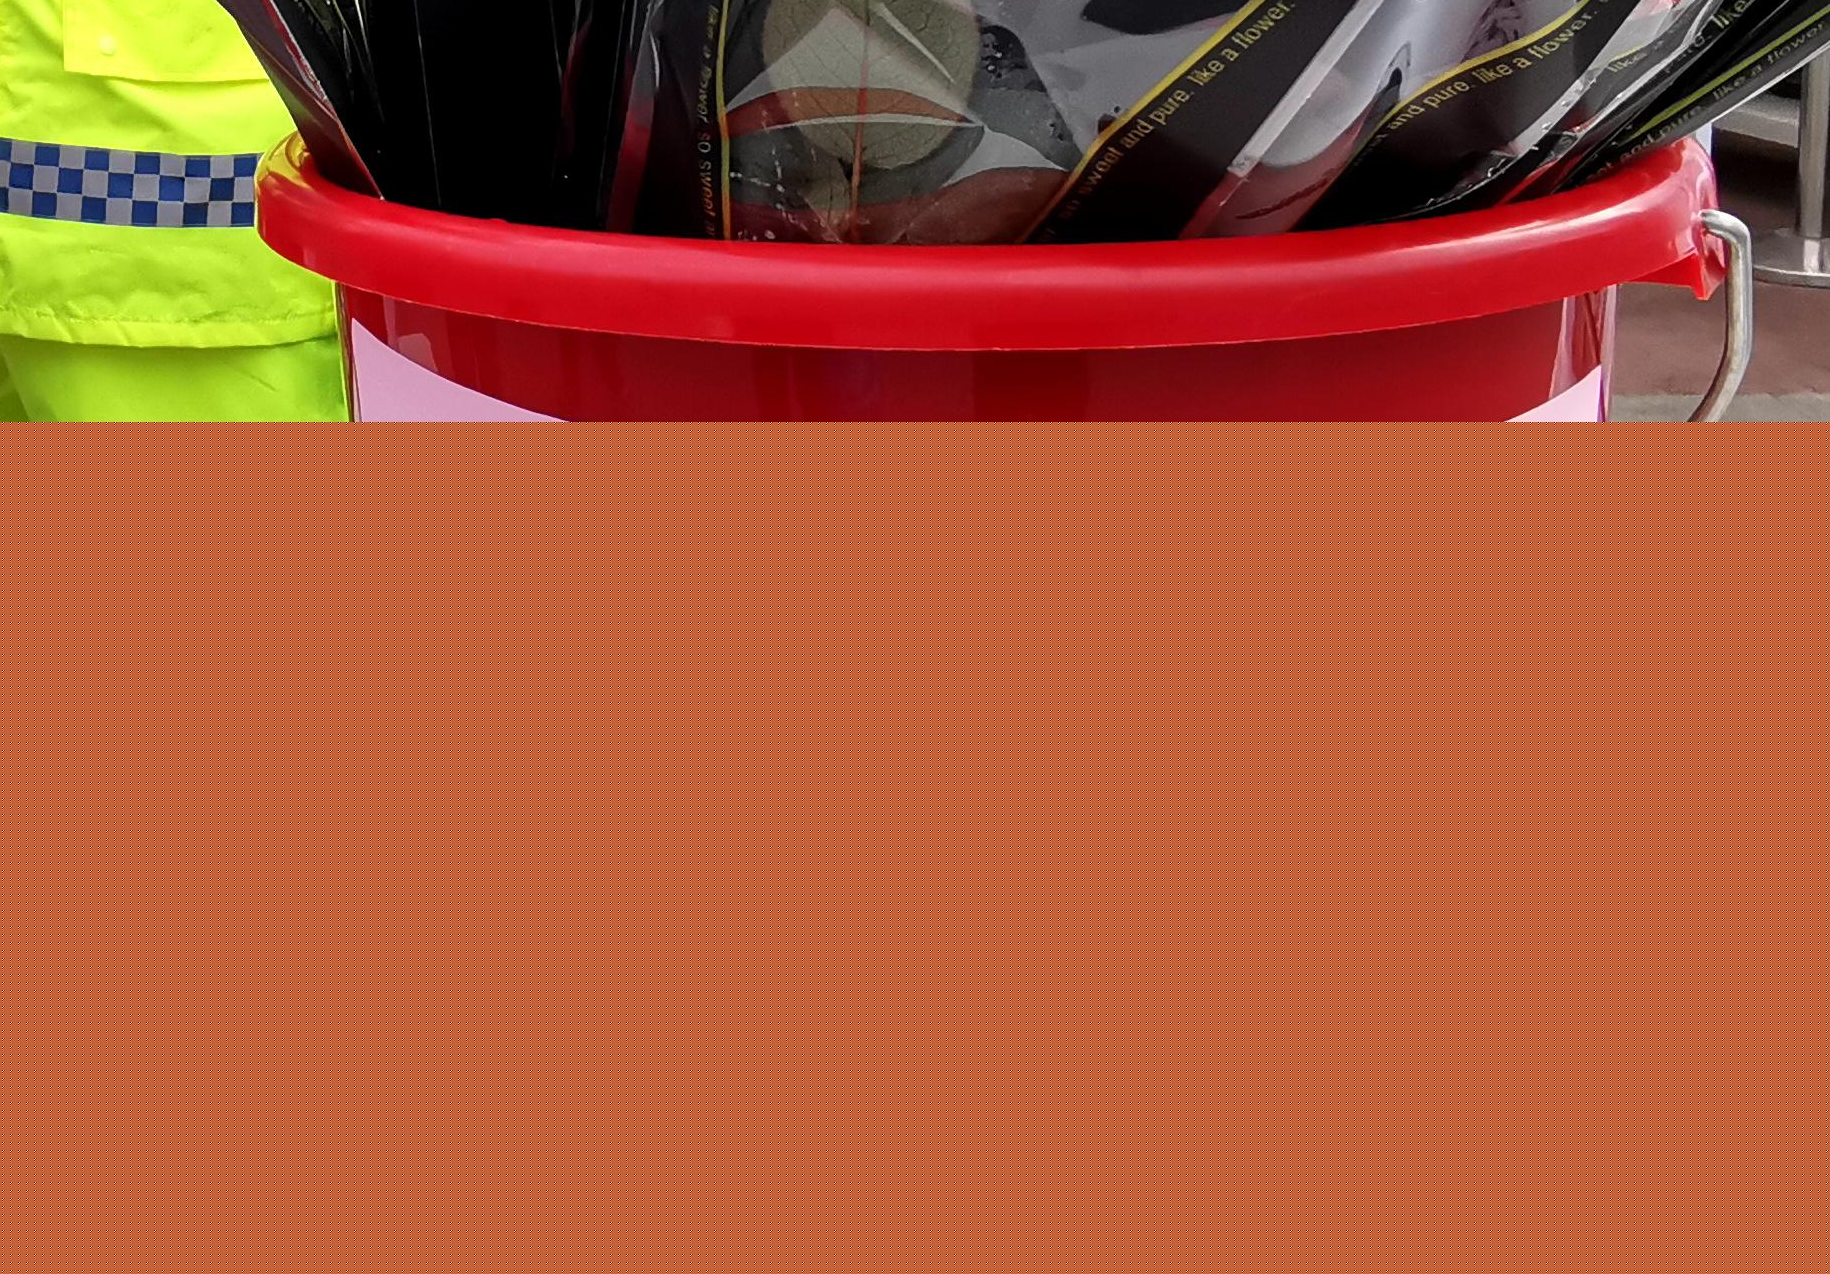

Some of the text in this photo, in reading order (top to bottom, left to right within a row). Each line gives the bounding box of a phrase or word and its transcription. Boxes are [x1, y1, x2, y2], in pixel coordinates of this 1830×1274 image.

[1711, 0, 1746, 29] like
[1120, 118, 1155, 150] and
[1187, 59, 1225, 86] like
[1222, 46, 1239, 61] a
[1387, 102, 1425, 130] and
[1472, 61, 1514, 84] like
[1513, 54, 1532, 69] a
